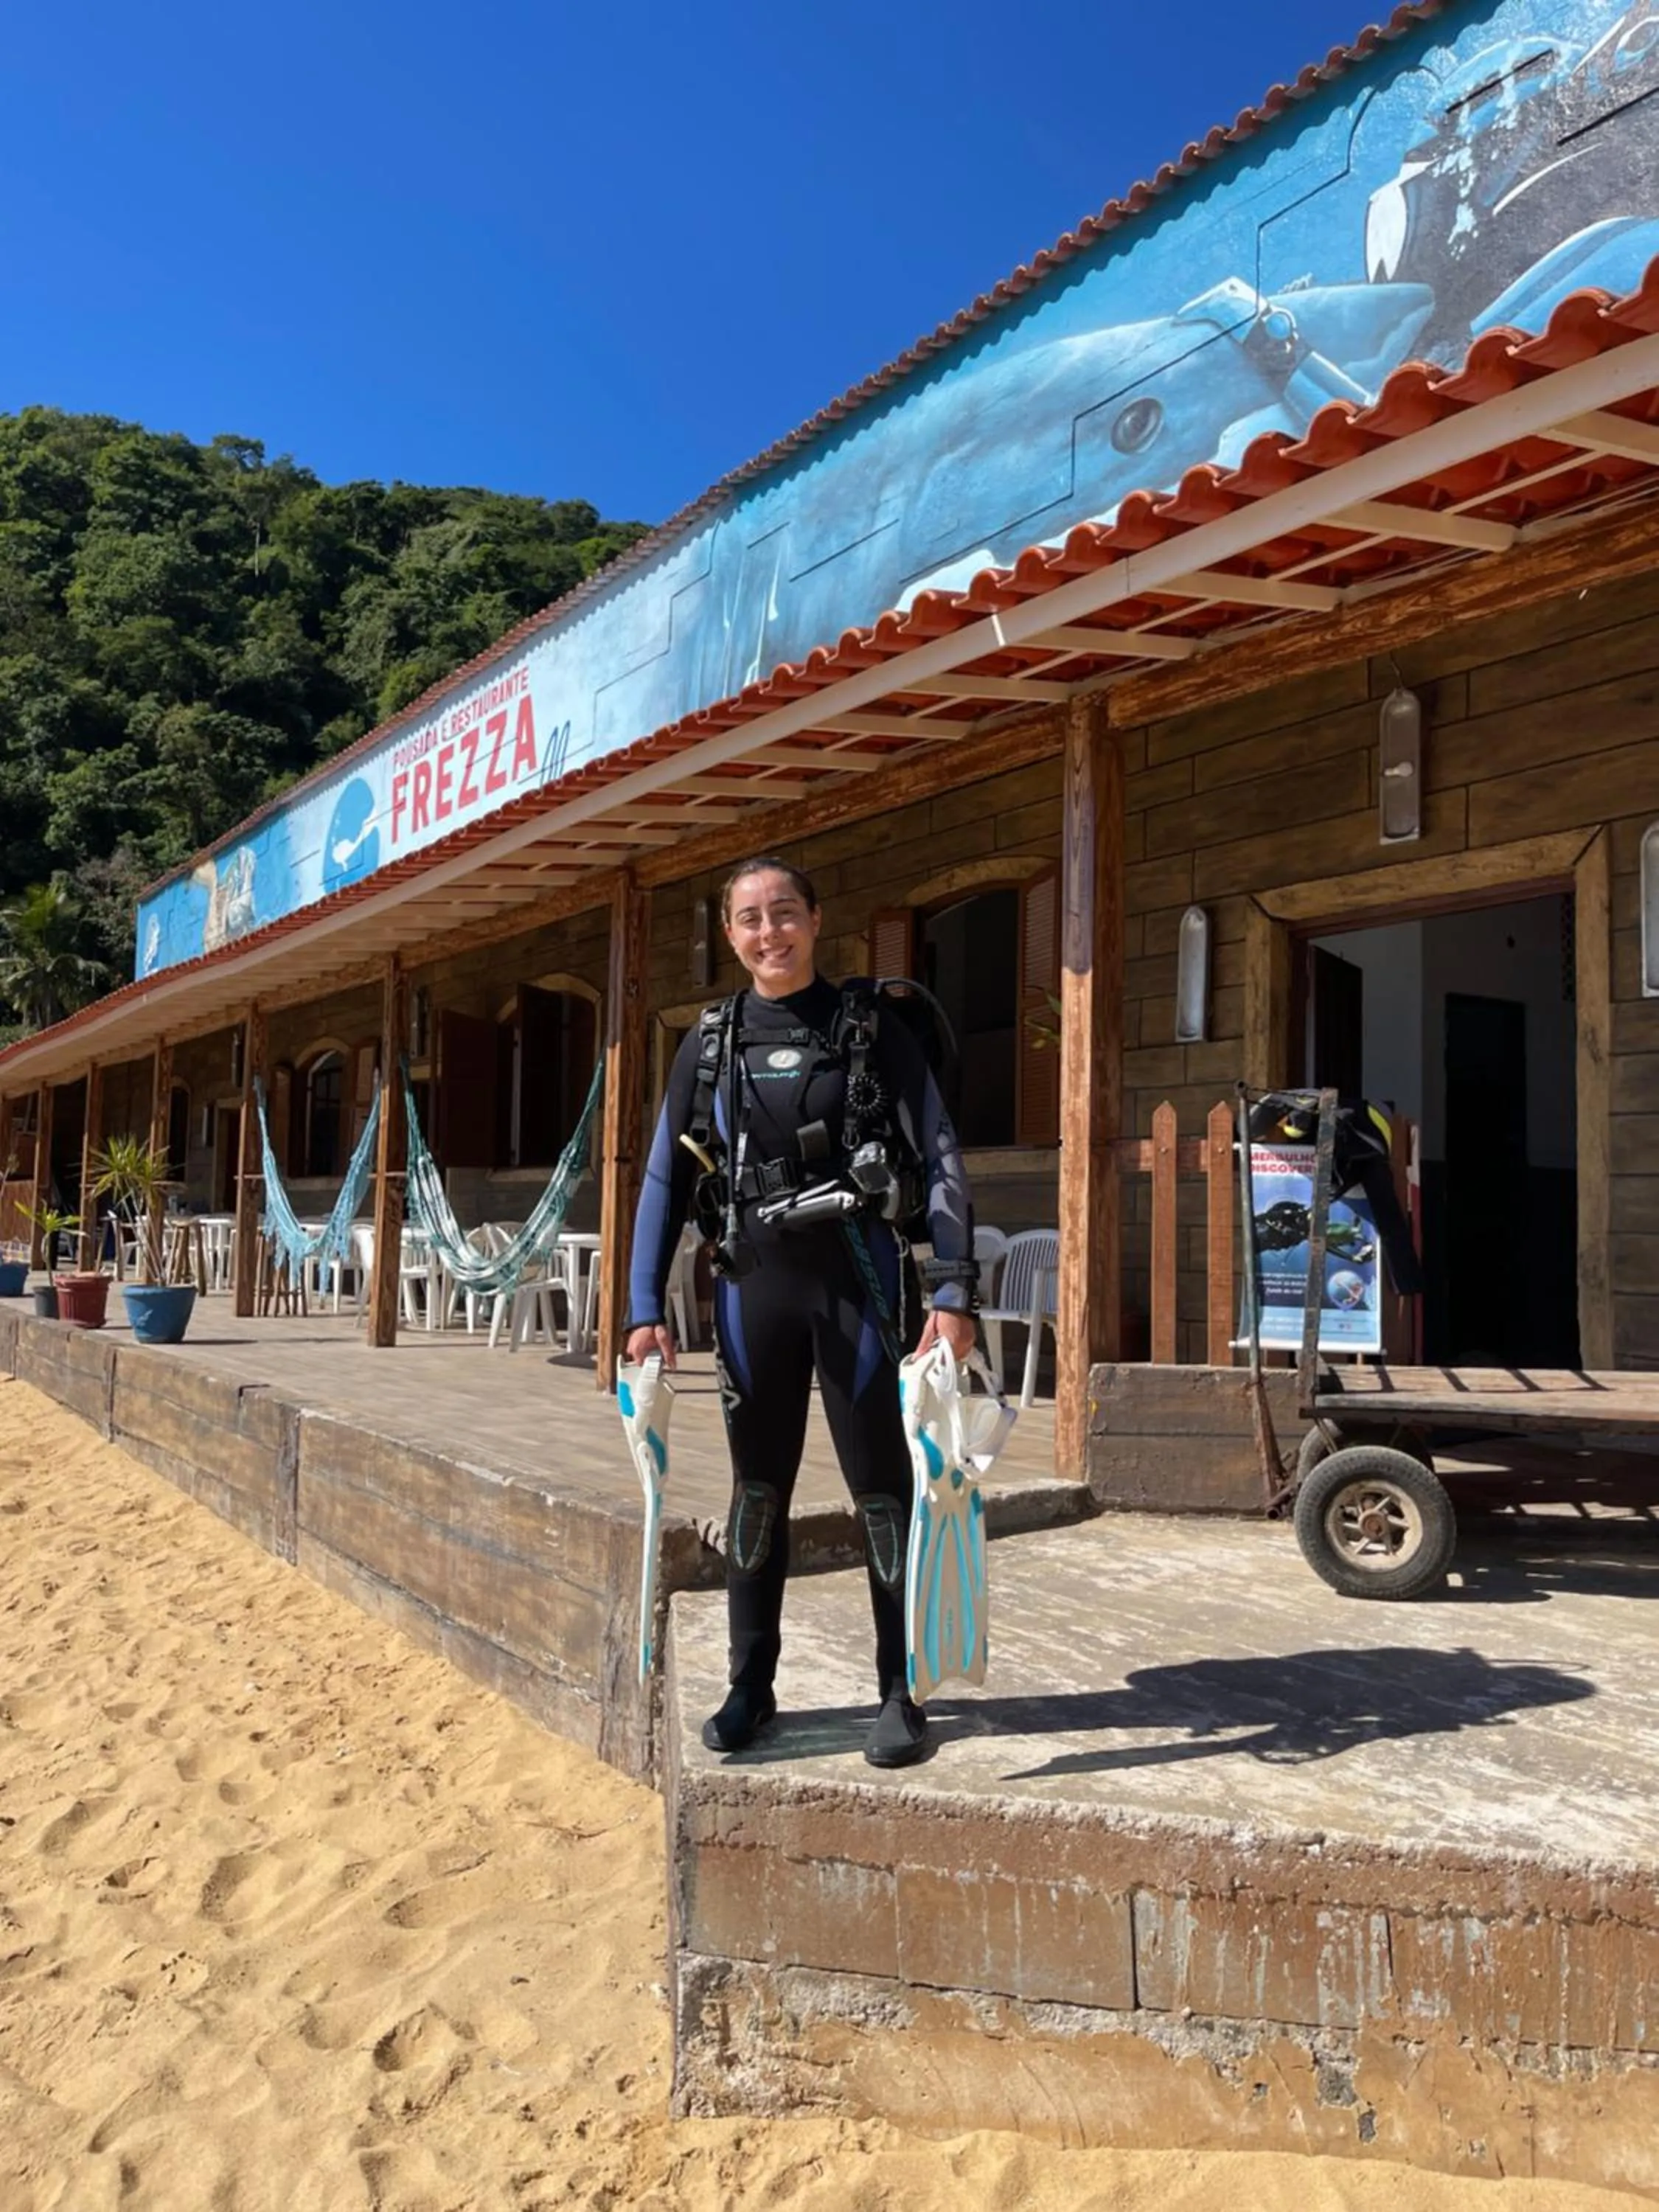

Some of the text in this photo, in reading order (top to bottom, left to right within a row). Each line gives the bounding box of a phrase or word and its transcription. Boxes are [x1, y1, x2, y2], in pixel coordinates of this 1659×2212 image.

[442, 719, 448, 742] E
[451, 666, 529, 735] RESTAURANTE
[392, 693, 538, 845] FREZZA
[1250, 1164, 1317, 1174] DISCOVER
